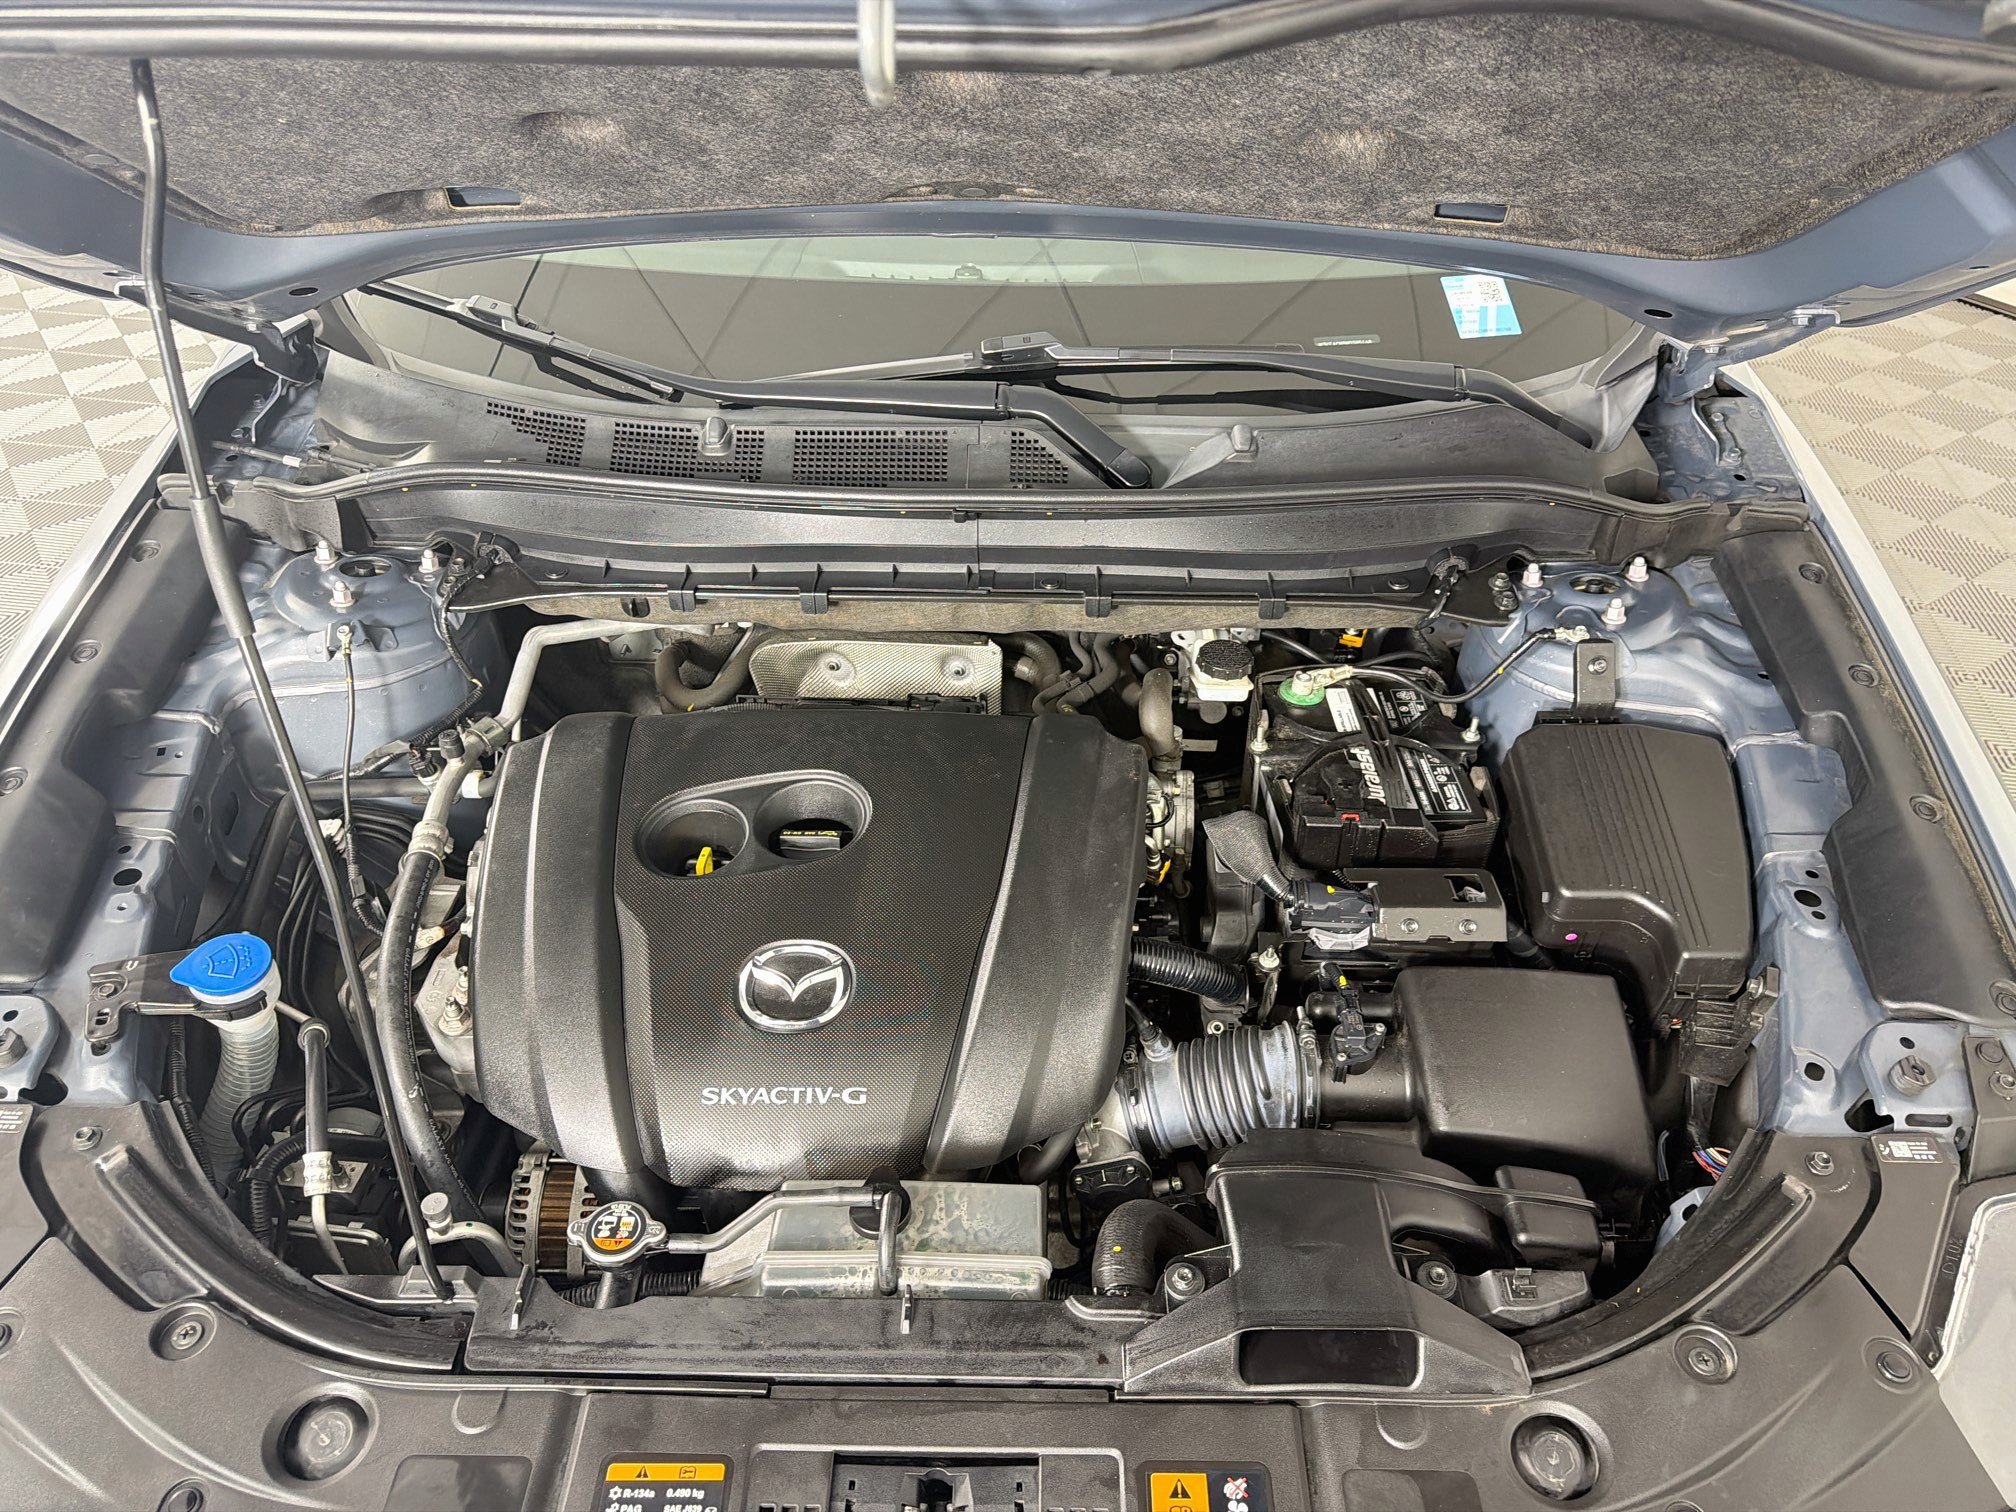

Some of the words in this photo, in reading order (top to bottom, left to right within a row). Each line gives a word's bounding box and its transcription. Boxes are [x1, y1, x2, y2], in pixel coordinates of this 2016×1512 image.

[700, 1086, 868, 1105] SKYACTIV-G
[622, 1488, 655, 1498] R-134a
[692, 1488, 705, 1500] kg
